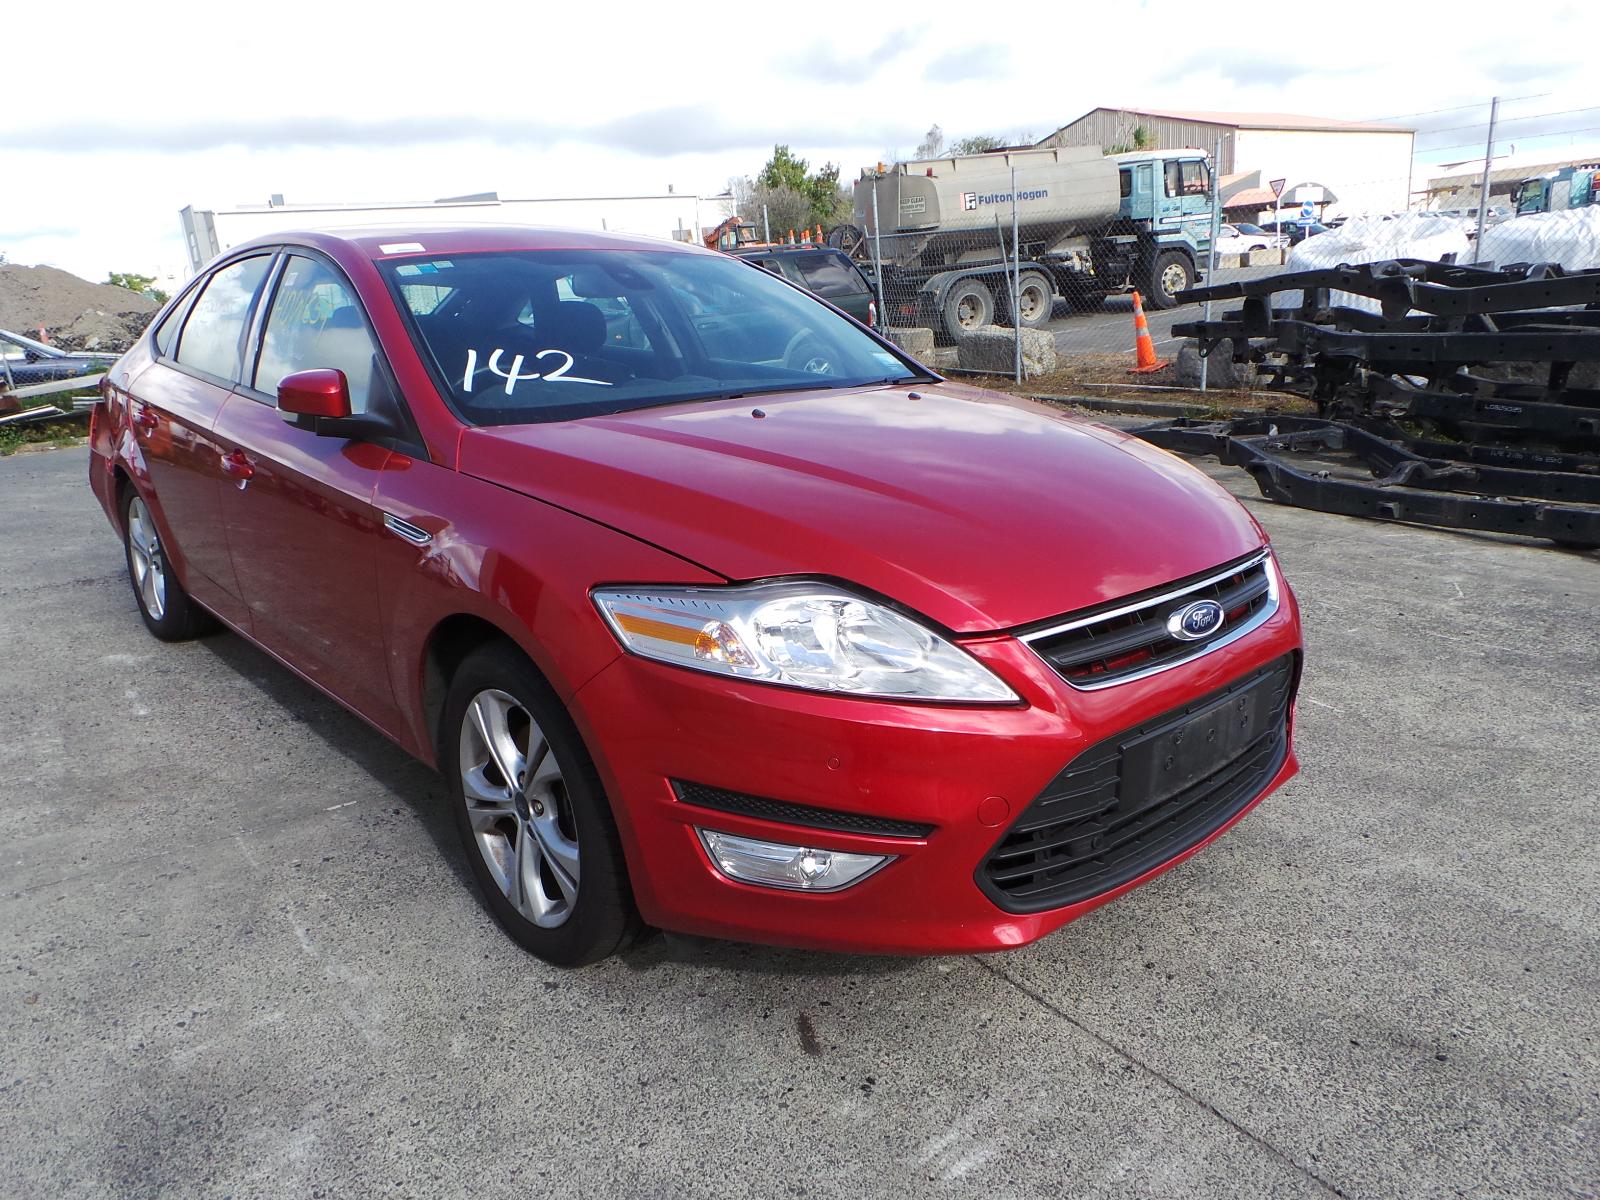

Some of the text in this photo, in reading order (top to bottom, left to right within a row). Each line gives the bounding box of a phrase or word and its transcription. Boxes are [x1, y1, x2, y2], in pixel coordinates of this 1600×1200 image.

[978, 189, 1048, 205] Fulton Hogan
[463, 348, 614, 396] 142
[1192, 608, 1215, 629] Ford
